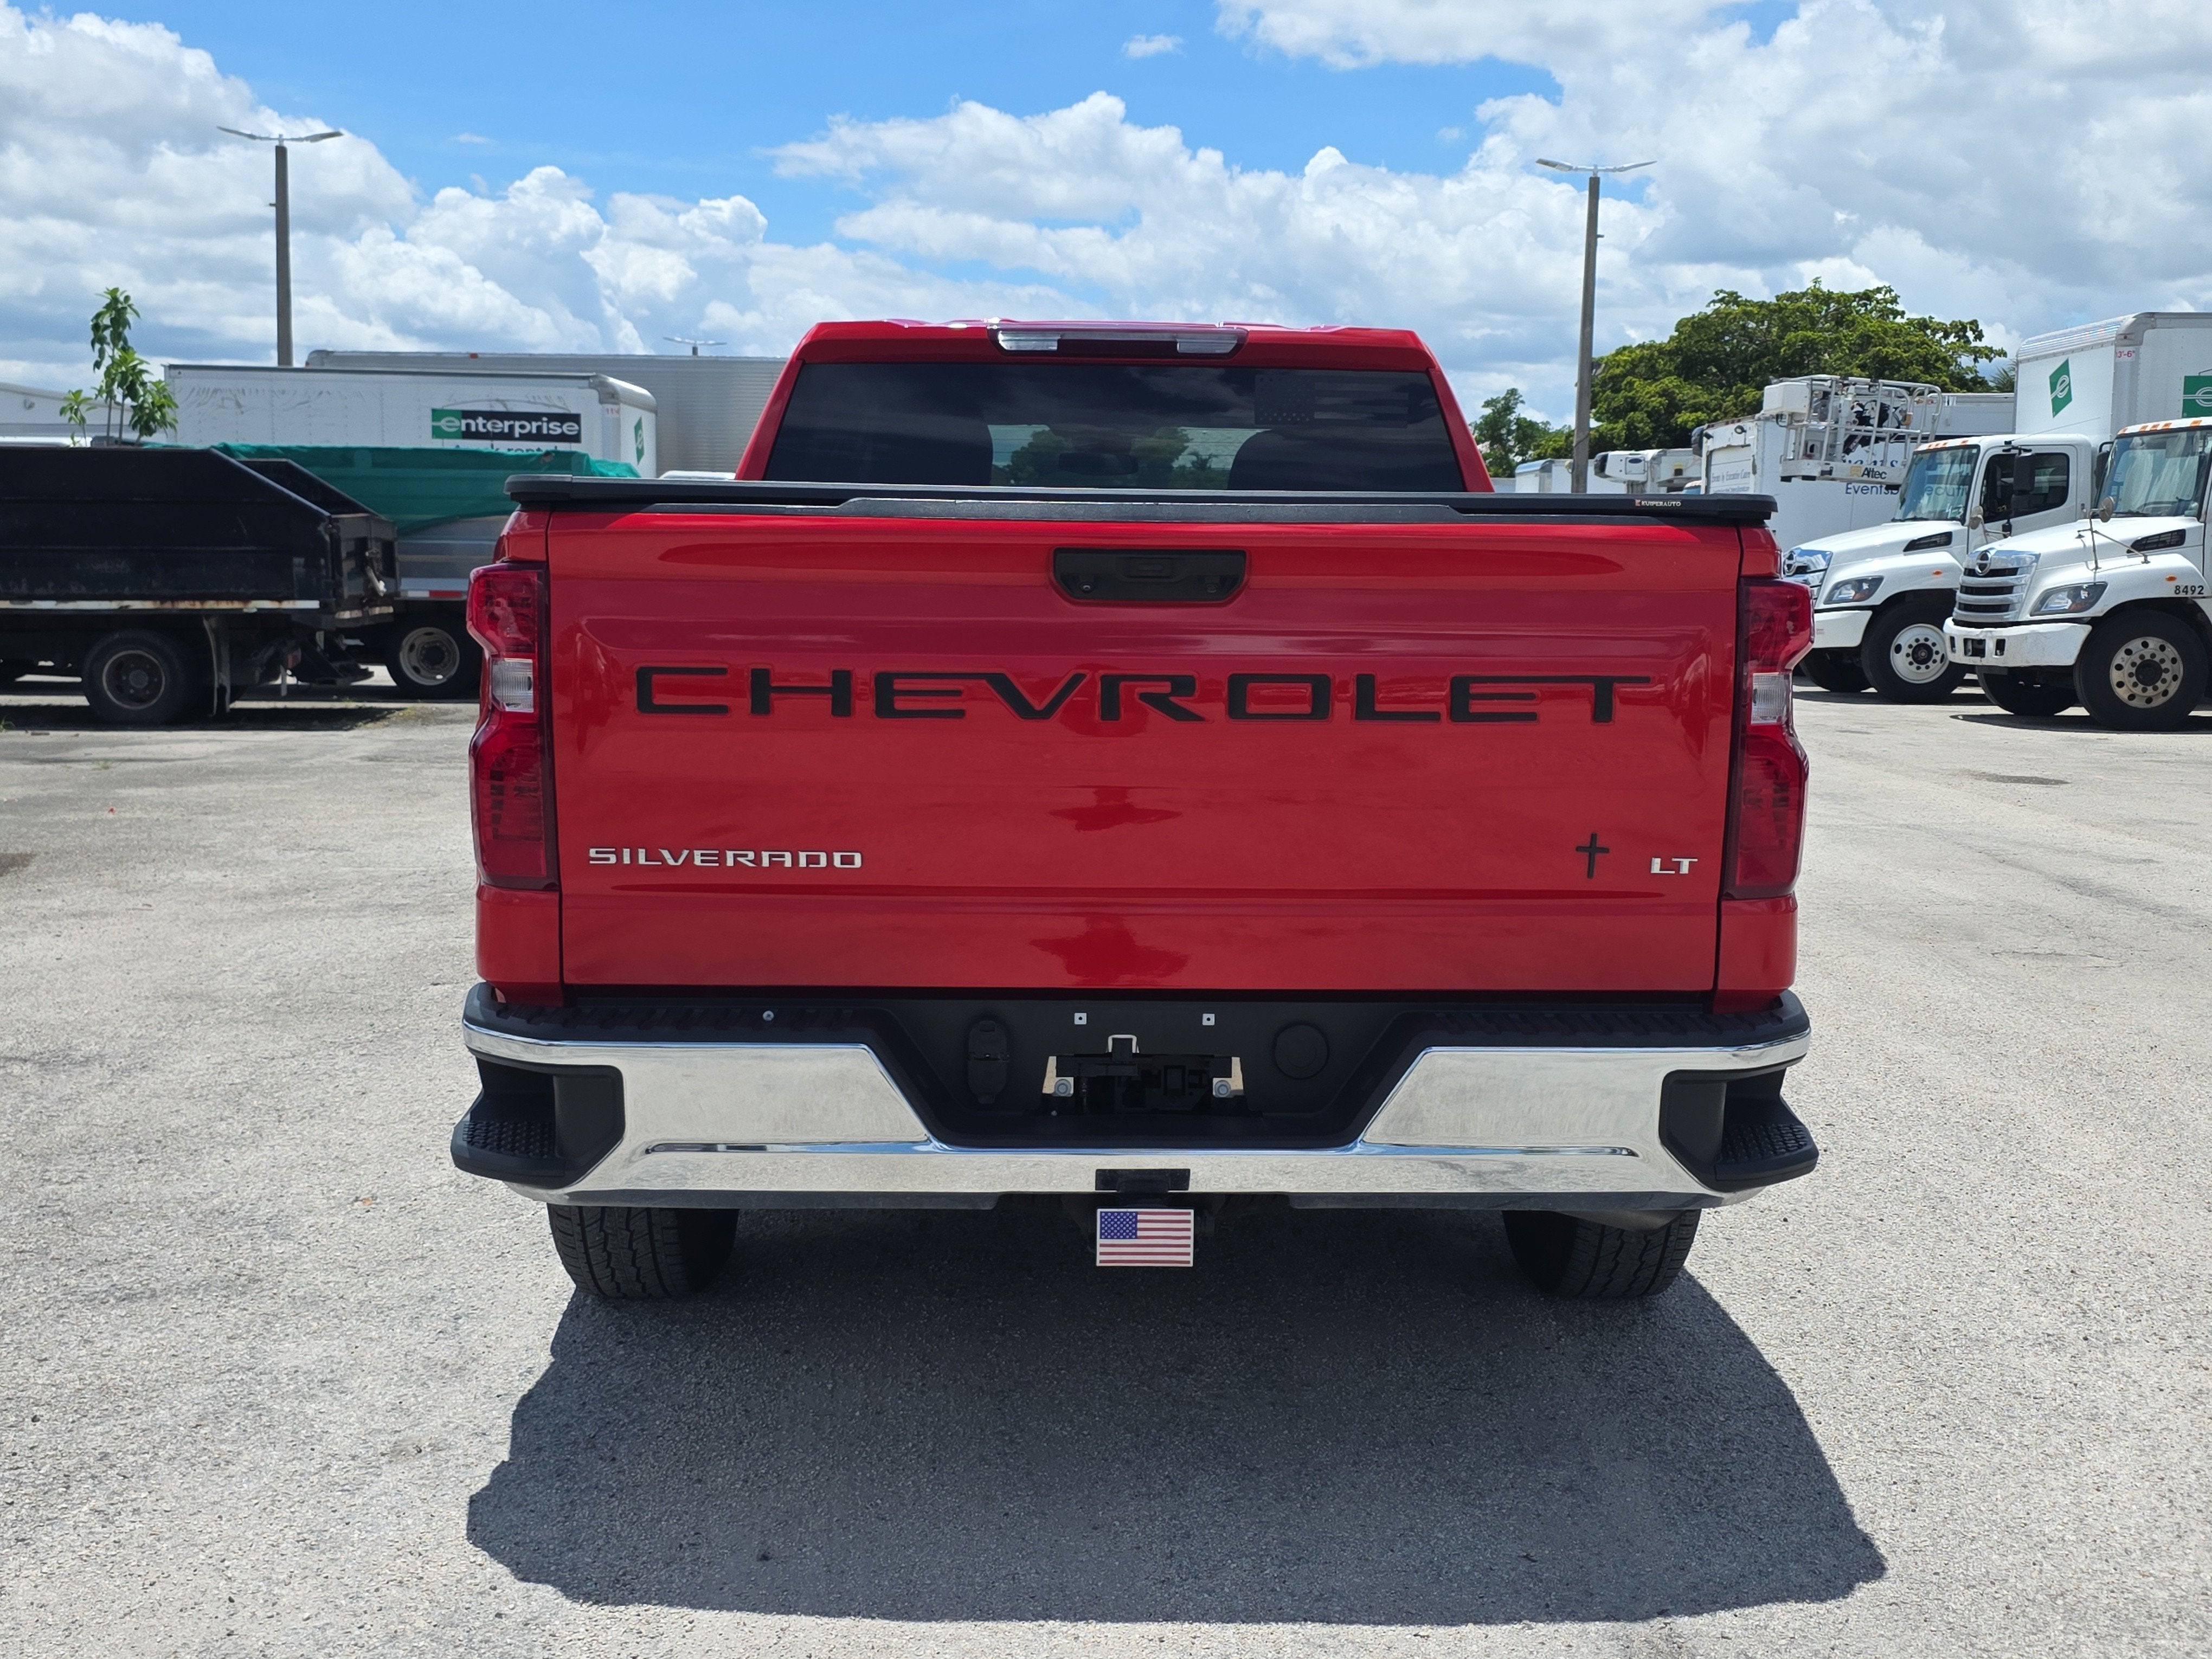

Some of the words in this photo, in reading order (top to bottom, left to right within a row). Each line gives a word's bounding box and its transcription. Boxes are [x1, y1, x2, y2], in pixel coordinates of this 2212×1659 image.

[433, 416, 579, 438] enterprise
[1861, 467, 1887, 480] Altec
[2174, 585, 2204, 595] 8492
[635, 666, 1651, 723] CHEVROLET
[589, 847, 863, 868] SILVERADO
[1650, 857, 1698, 874] LT
